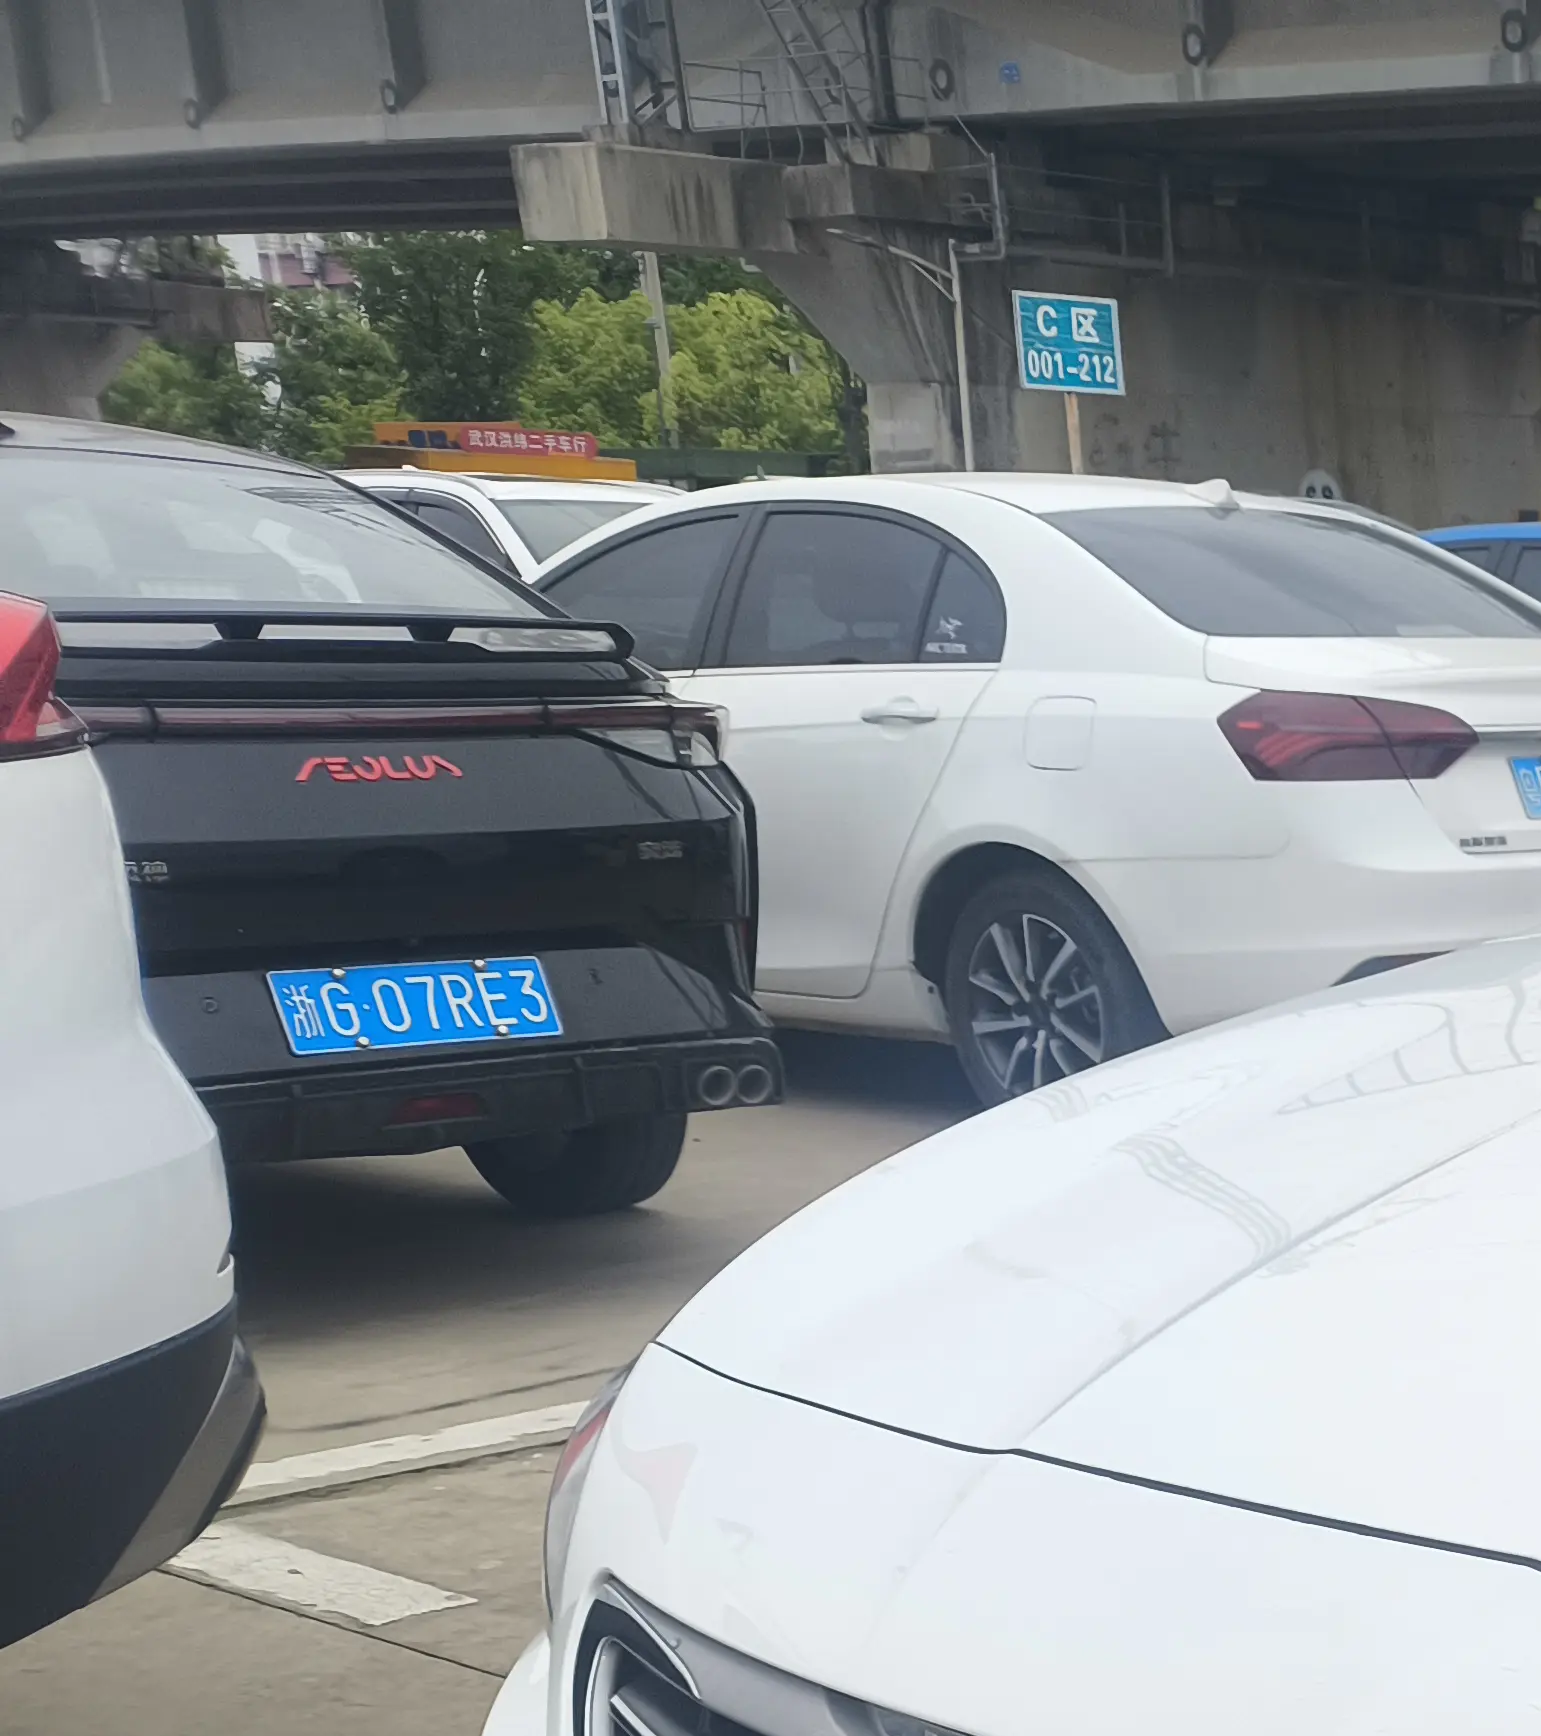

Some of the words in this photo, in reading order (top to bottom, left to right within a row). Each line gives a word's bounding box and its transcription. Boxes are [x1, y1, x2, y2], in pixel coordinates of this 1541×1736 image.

[1036, 304, 1058, 338] C
[1070, 306, 1100, 344] 区
[1027, 349, 1116, 384] 001-212
